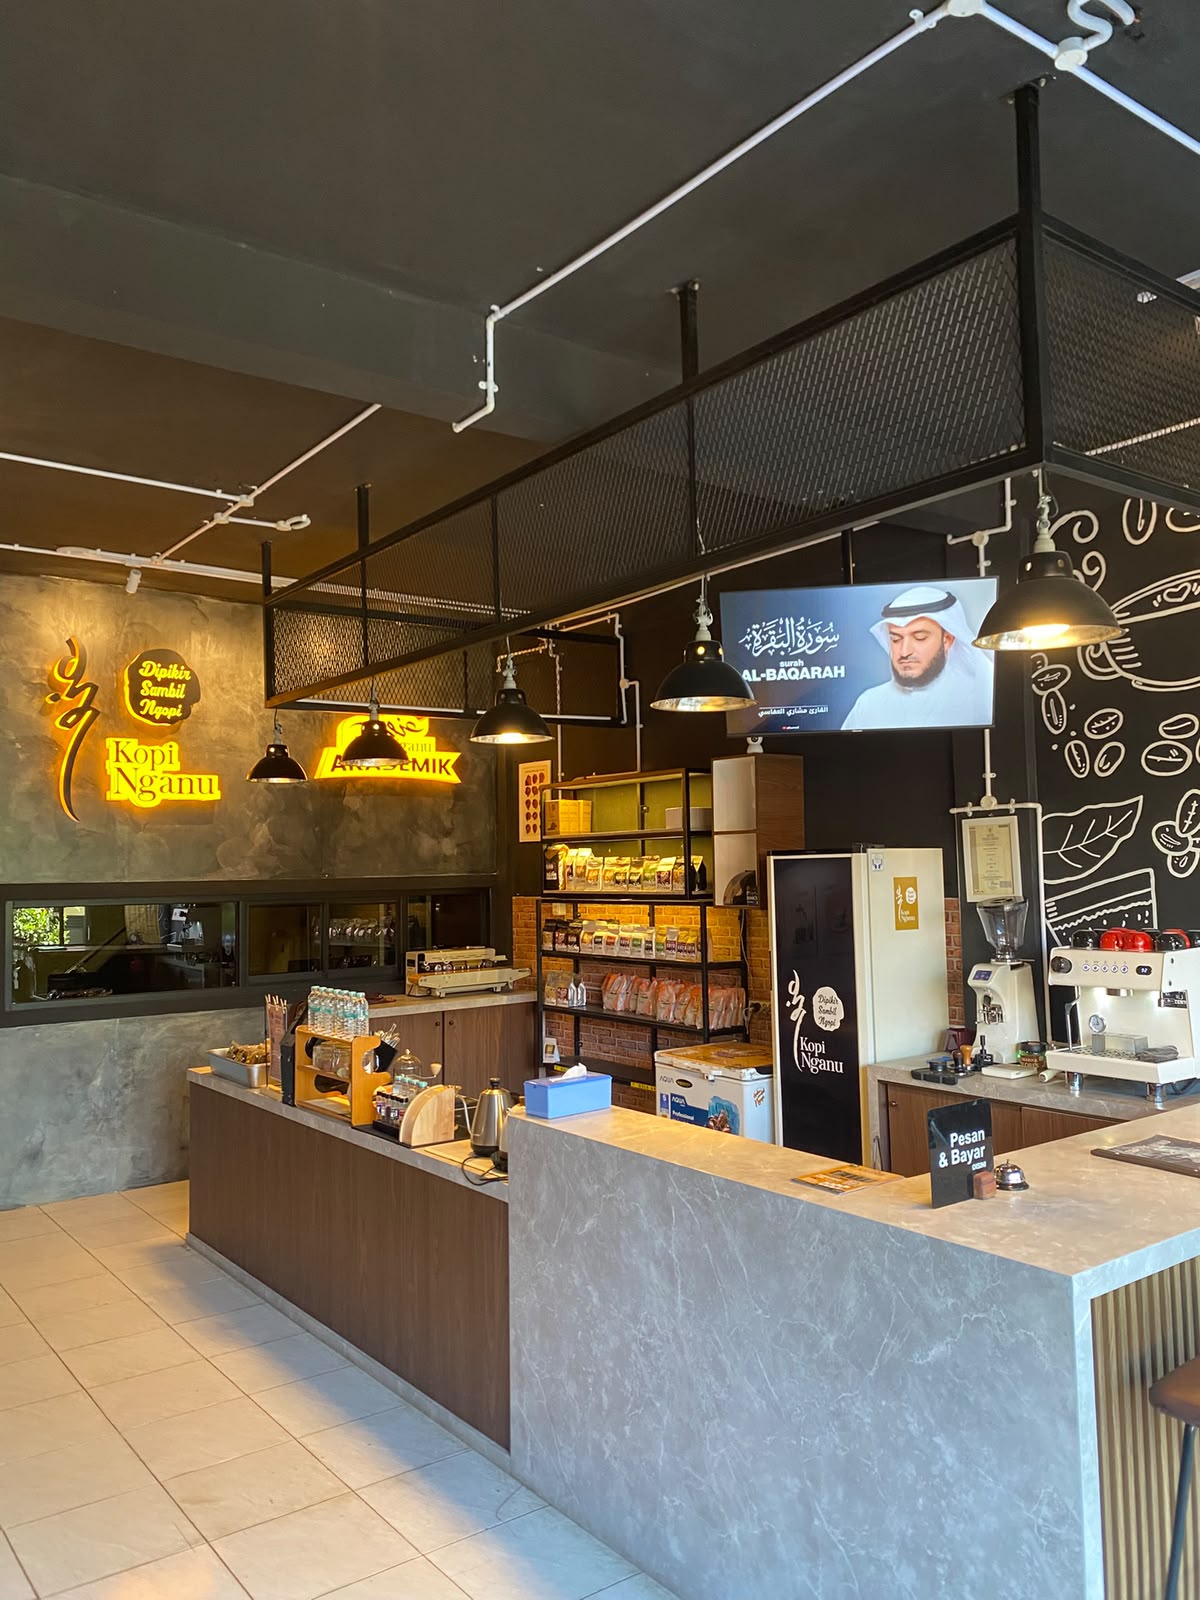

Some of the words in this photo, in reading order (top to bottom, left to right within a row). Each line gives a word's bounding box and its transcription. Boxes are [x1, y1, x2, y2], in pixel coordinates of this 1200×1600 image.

[138, 660, 192, 681] Dipikir
[742, 665, 846, 682] AL-BAQARAH
[780, 659, 804, 667] surah
[140, 680, 186, 699] Sambil
[140, 699, 183, 720] Ngopi
[113, 740, 175, 771] Kopi
[114, 767, 215, 801] Nganu
[800, 1036, 826, 1057] Kopi
[801, 1051, 844, 1074] Nganu
[659, 1075, 675, 1084] AQUA
[671, 1096, 686, 1105] AQUA
[950, 1129, 985, 1148] Pesan
[938, 1151, 949, 1168] &
[951, 1145, 986, 1166] Bayar
